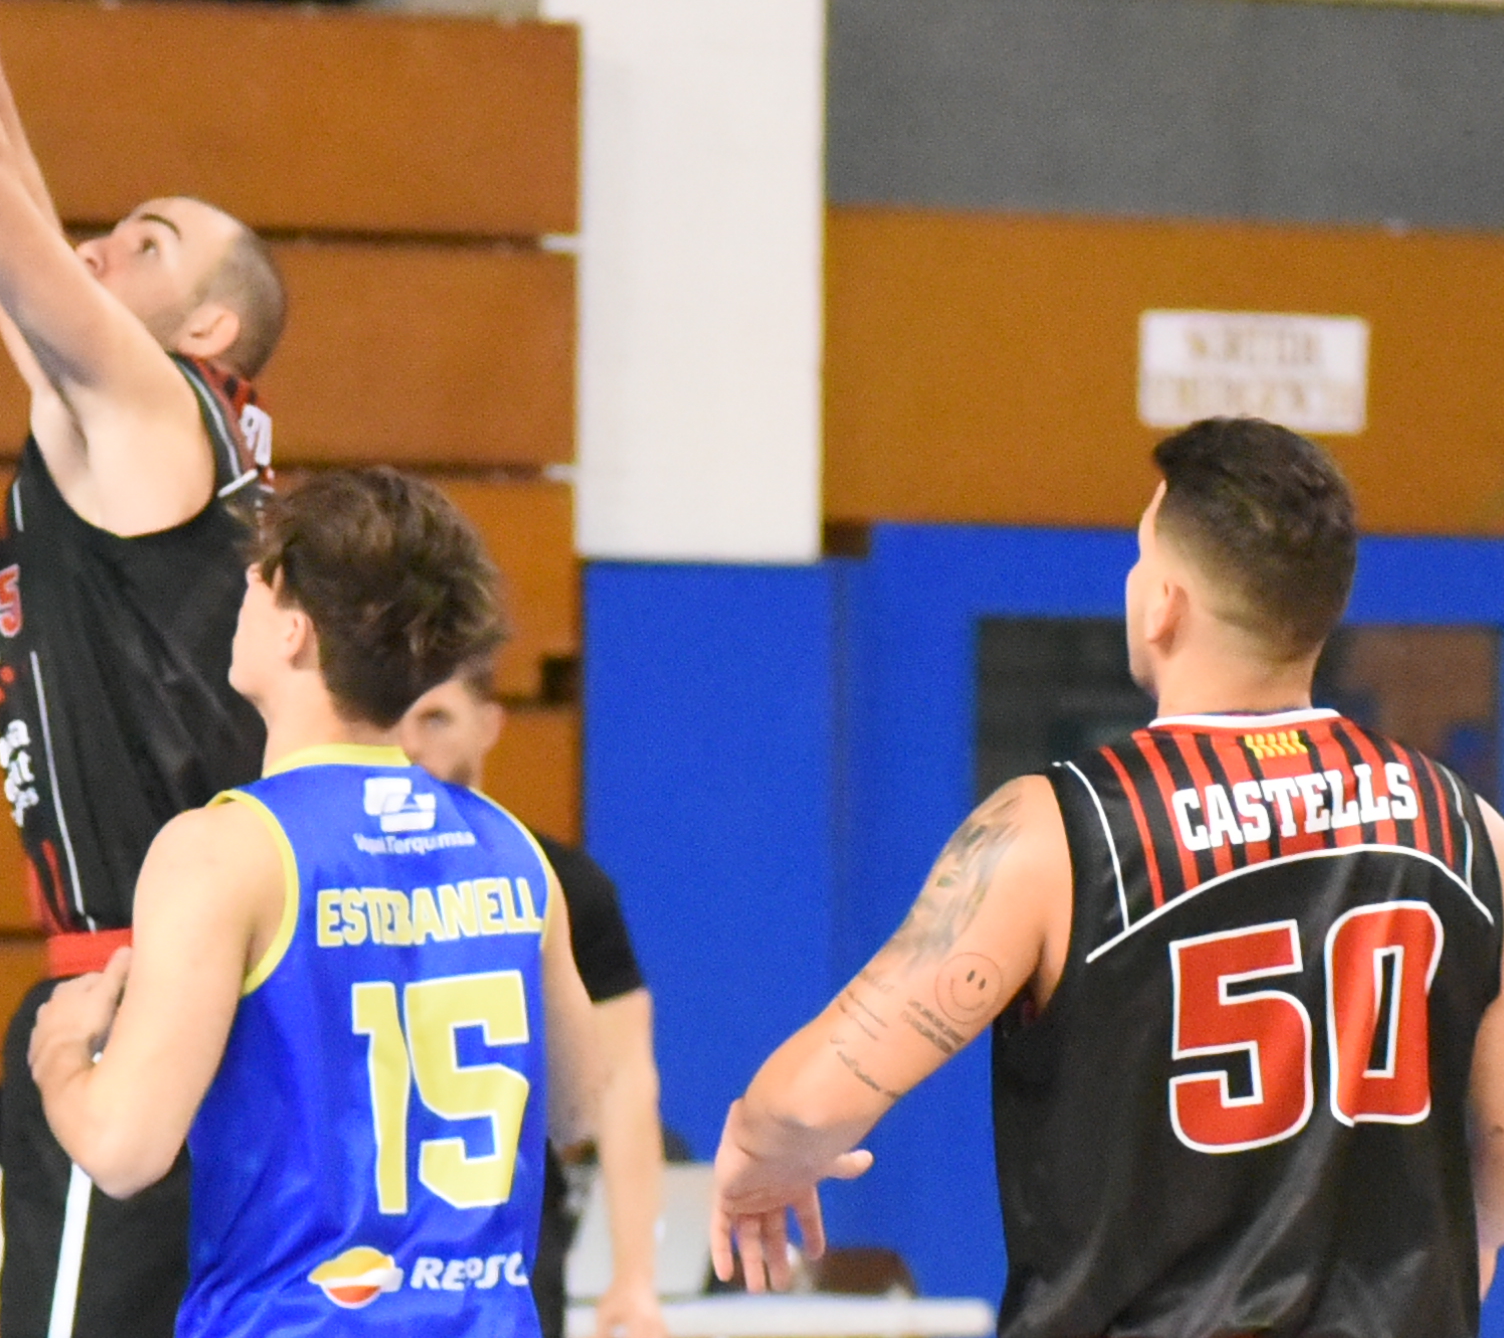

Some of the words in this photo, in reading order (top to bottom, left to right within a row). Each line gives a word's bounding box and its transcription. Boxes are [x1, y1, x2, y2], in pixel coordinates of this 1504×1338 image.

[1171, 762, 1419, 851] CASTELLS
[316, 878, 544, 948] ESTEBANELL
[352, 970, 530, 1215] 15
[1169, 900, 1444, 1154] 50
